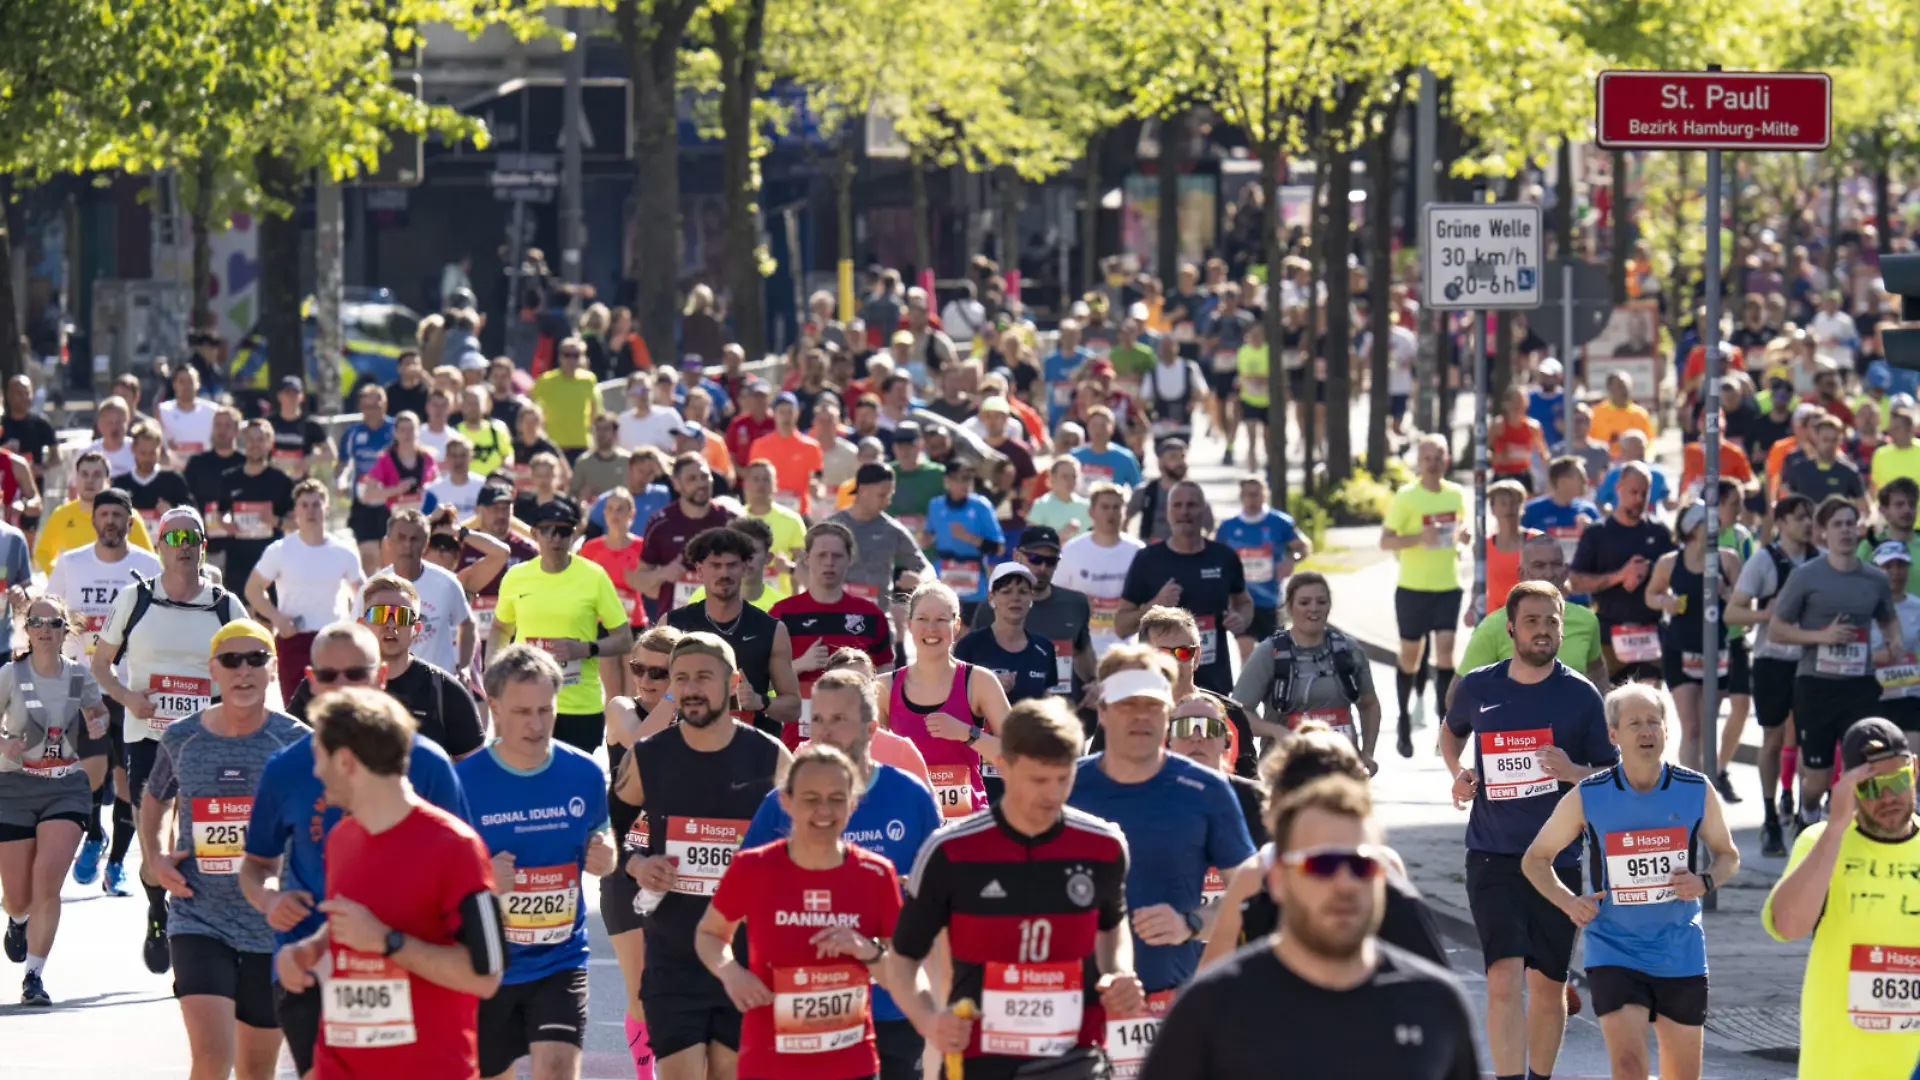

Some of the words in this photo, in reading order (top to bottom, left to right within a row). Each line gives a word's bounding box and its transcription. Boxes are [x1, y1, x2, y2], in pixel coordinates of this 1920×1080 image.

[1660, 84, 1694, 109] St.
[1706, 84, 1770, 110] Pauli
[1629, 118, 1677, 135] Bezirk
[1683, 119, 1799, 139] Hamburg-Mitte
[1436, 218, 1480, 238] Grüne
[1489, 217, 1531, 238] Welle
[1442, 247, 1465, 267] 30
[1475, 246, 1527, 266] km/h
[171, 680, 199, 690] Haspa
[159, 695, 199, 711] 11631
[1506, 735, 1537, 747] Haspa
[1497, 756, 1531, 771] 8550
[938, 788, 958, 806] 19
[1491, 788, 1516, 797] REWE
[481, 810, 527, 826] SIGNAL
[529, 805, 567, 820] IDUNA
[701, 824, 736, 837] Haspa
[844, 829, 883, 841] IDUNA
[1637, 835, 1671, 847] Haspa
[687, 846, 732, 866] 9366
[1627, 856, 1671, 877] 9513
[1677, 851, 1686, 861] G
[531, 872, 563, 885] Haspa
[509, 894, 565, 915] 22262
[1618, 891, 1647, 902] REWE
[775, 910, 860, 928] DANMARK
[1018, 918, 1052, 963] 10
[810, 970, 849, 984] Haspa
[1023, 969, 1065, 985] Haspa
[335, 984, 391, 1009] 10406
[1872, 977, 1920, 1000] 8630
[792, 992, 853, 1020] F2507
[1005, 999, 1054, 1018] 8226
